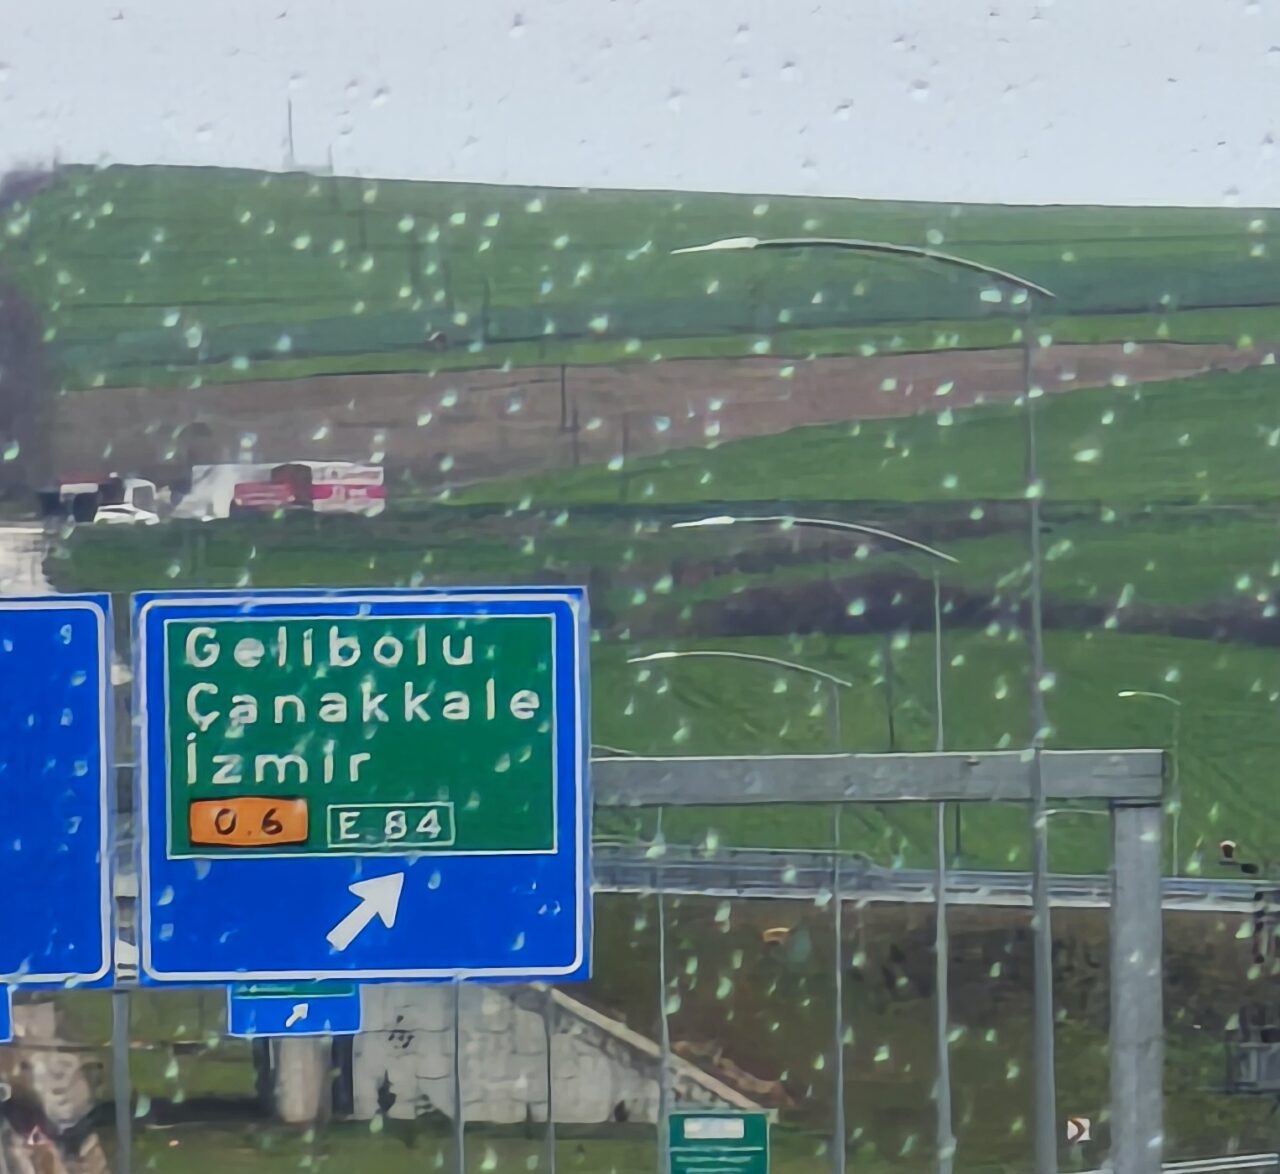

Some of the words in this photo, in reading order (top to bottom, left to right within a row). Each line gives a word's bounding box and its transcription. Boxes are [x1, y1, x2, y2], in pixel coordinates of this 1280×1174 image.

[185, 625, 473, 668] Gelibolu
[186, 679, 540, 731] Çanakkale
[186, 733, 371, 784] İzmir
